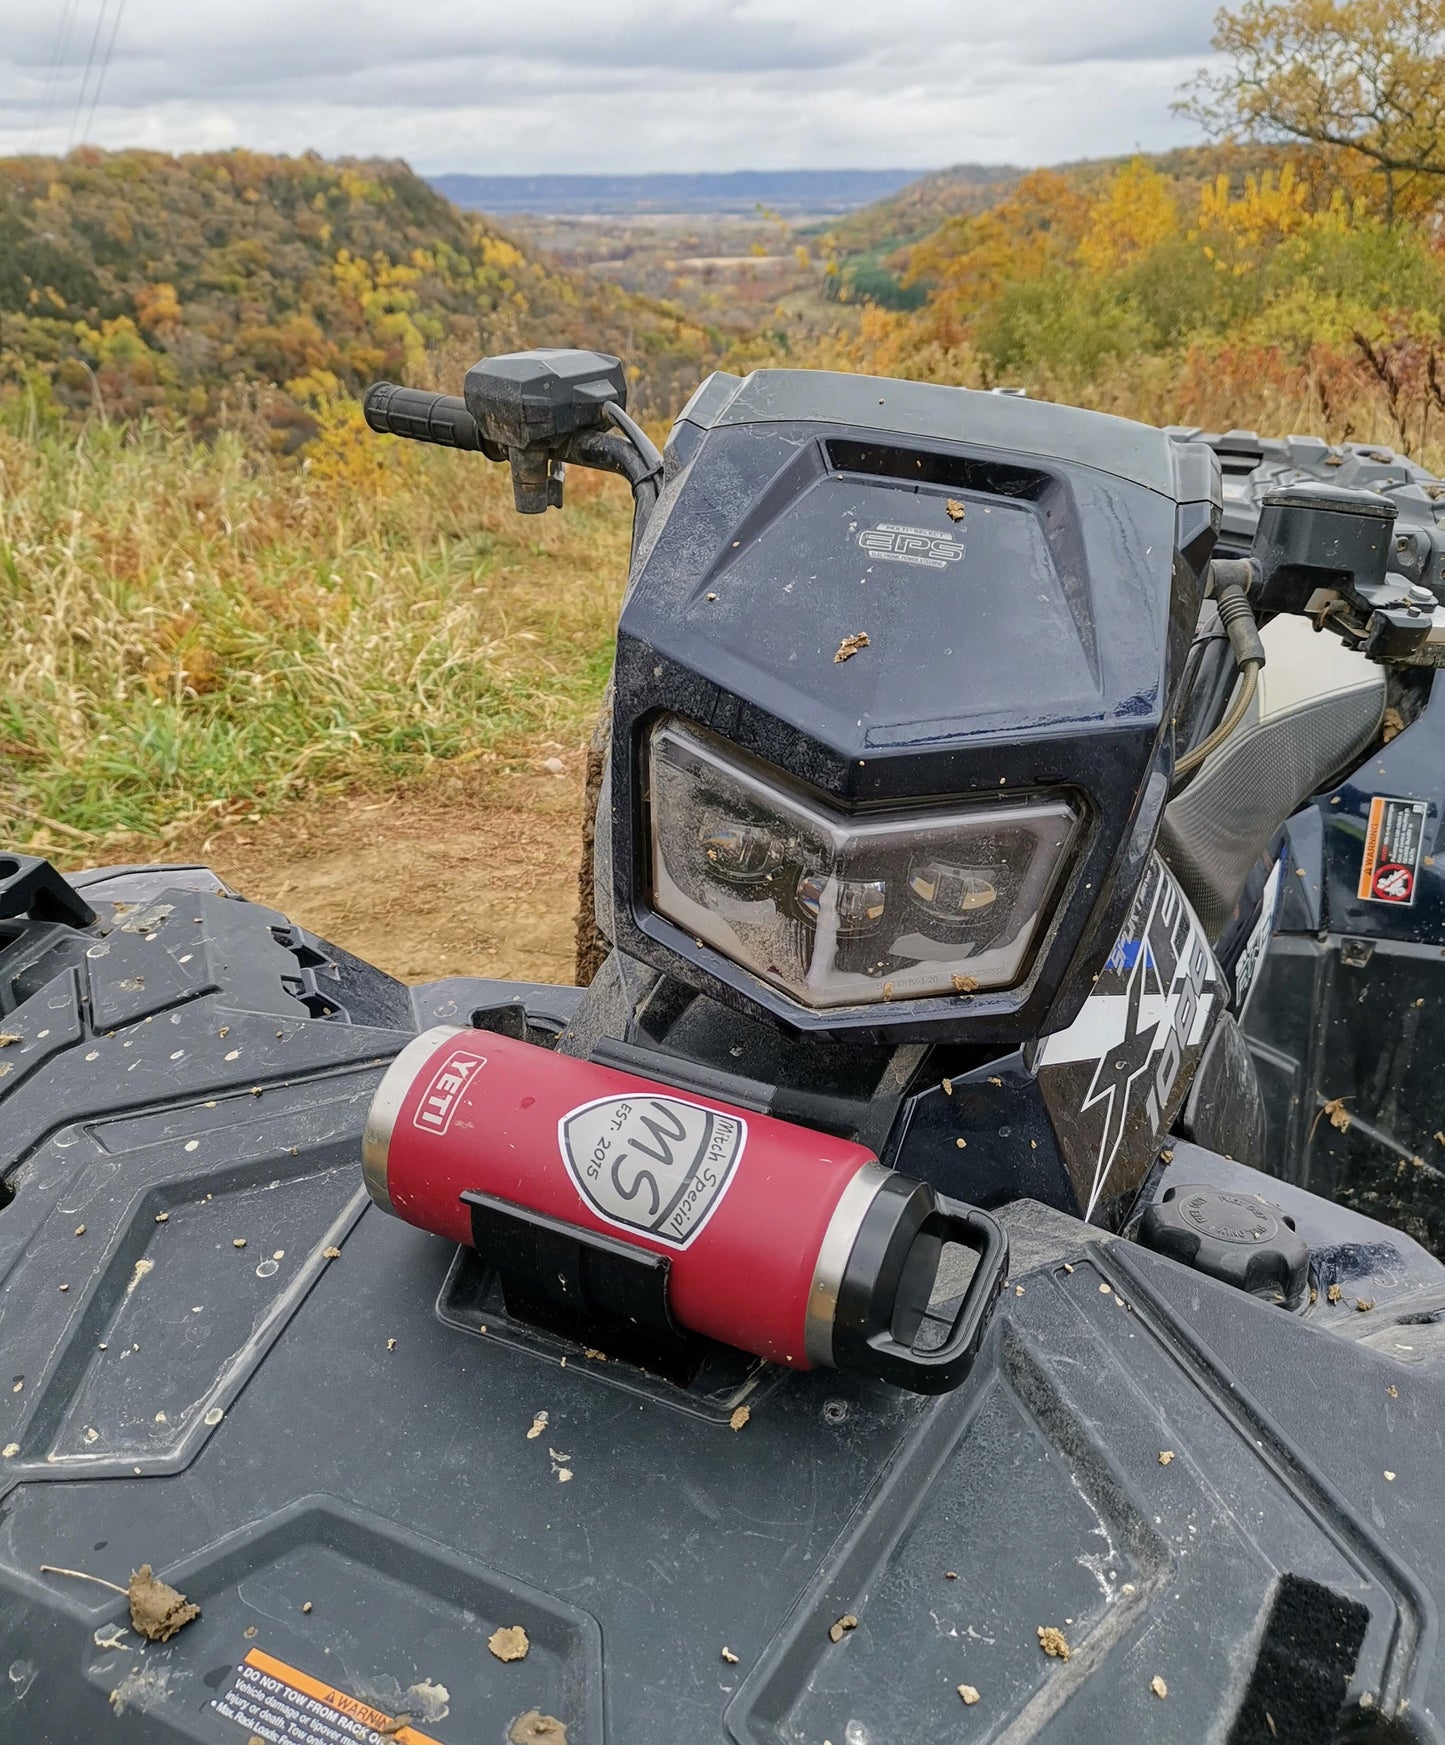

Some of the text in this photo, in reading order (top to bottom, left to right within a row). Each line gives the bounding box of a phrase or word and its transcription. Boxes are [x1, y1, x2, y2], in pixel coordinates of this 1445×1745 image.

[859, 530, 965, 561] EPS
[1364, 823, 1379, 866] WARNING
[421, 1060, 478, 1126] YETI
[586, 1102, 633, 1181] EST. 2015
[611, 1101, 687, 1216] MS
[670, 1119, 735, 1237] Mitch Special
[215, 1701, 235, 1719] Max.
[233, 1711, 256, 1730] Rack
[252, 1721, 281, 1742] Loads:
[224, 1690, 251, 1711] injury
[248, 1704, 261, 1715] or
[259, 1709, 286, 1730] death.
[287, 1722, 308, 1740] Tow
[234, 1678, 266, 1701] Vehicle
[264, 1695, 300, 1719] damage
[299, 1714, 312, 1724] or
[309, 1718, 342, 1741] tipover
[242, 1667, 261, 1682] DO
[260, 1675, 284, 1694] NOT
[282, 1686, 309, 1706] TOW
[306, 1699, 340, 1723] FROM
[336, 1715, 370, 1738] RACK
[337, 1695, 388, 1731] WARNIN
